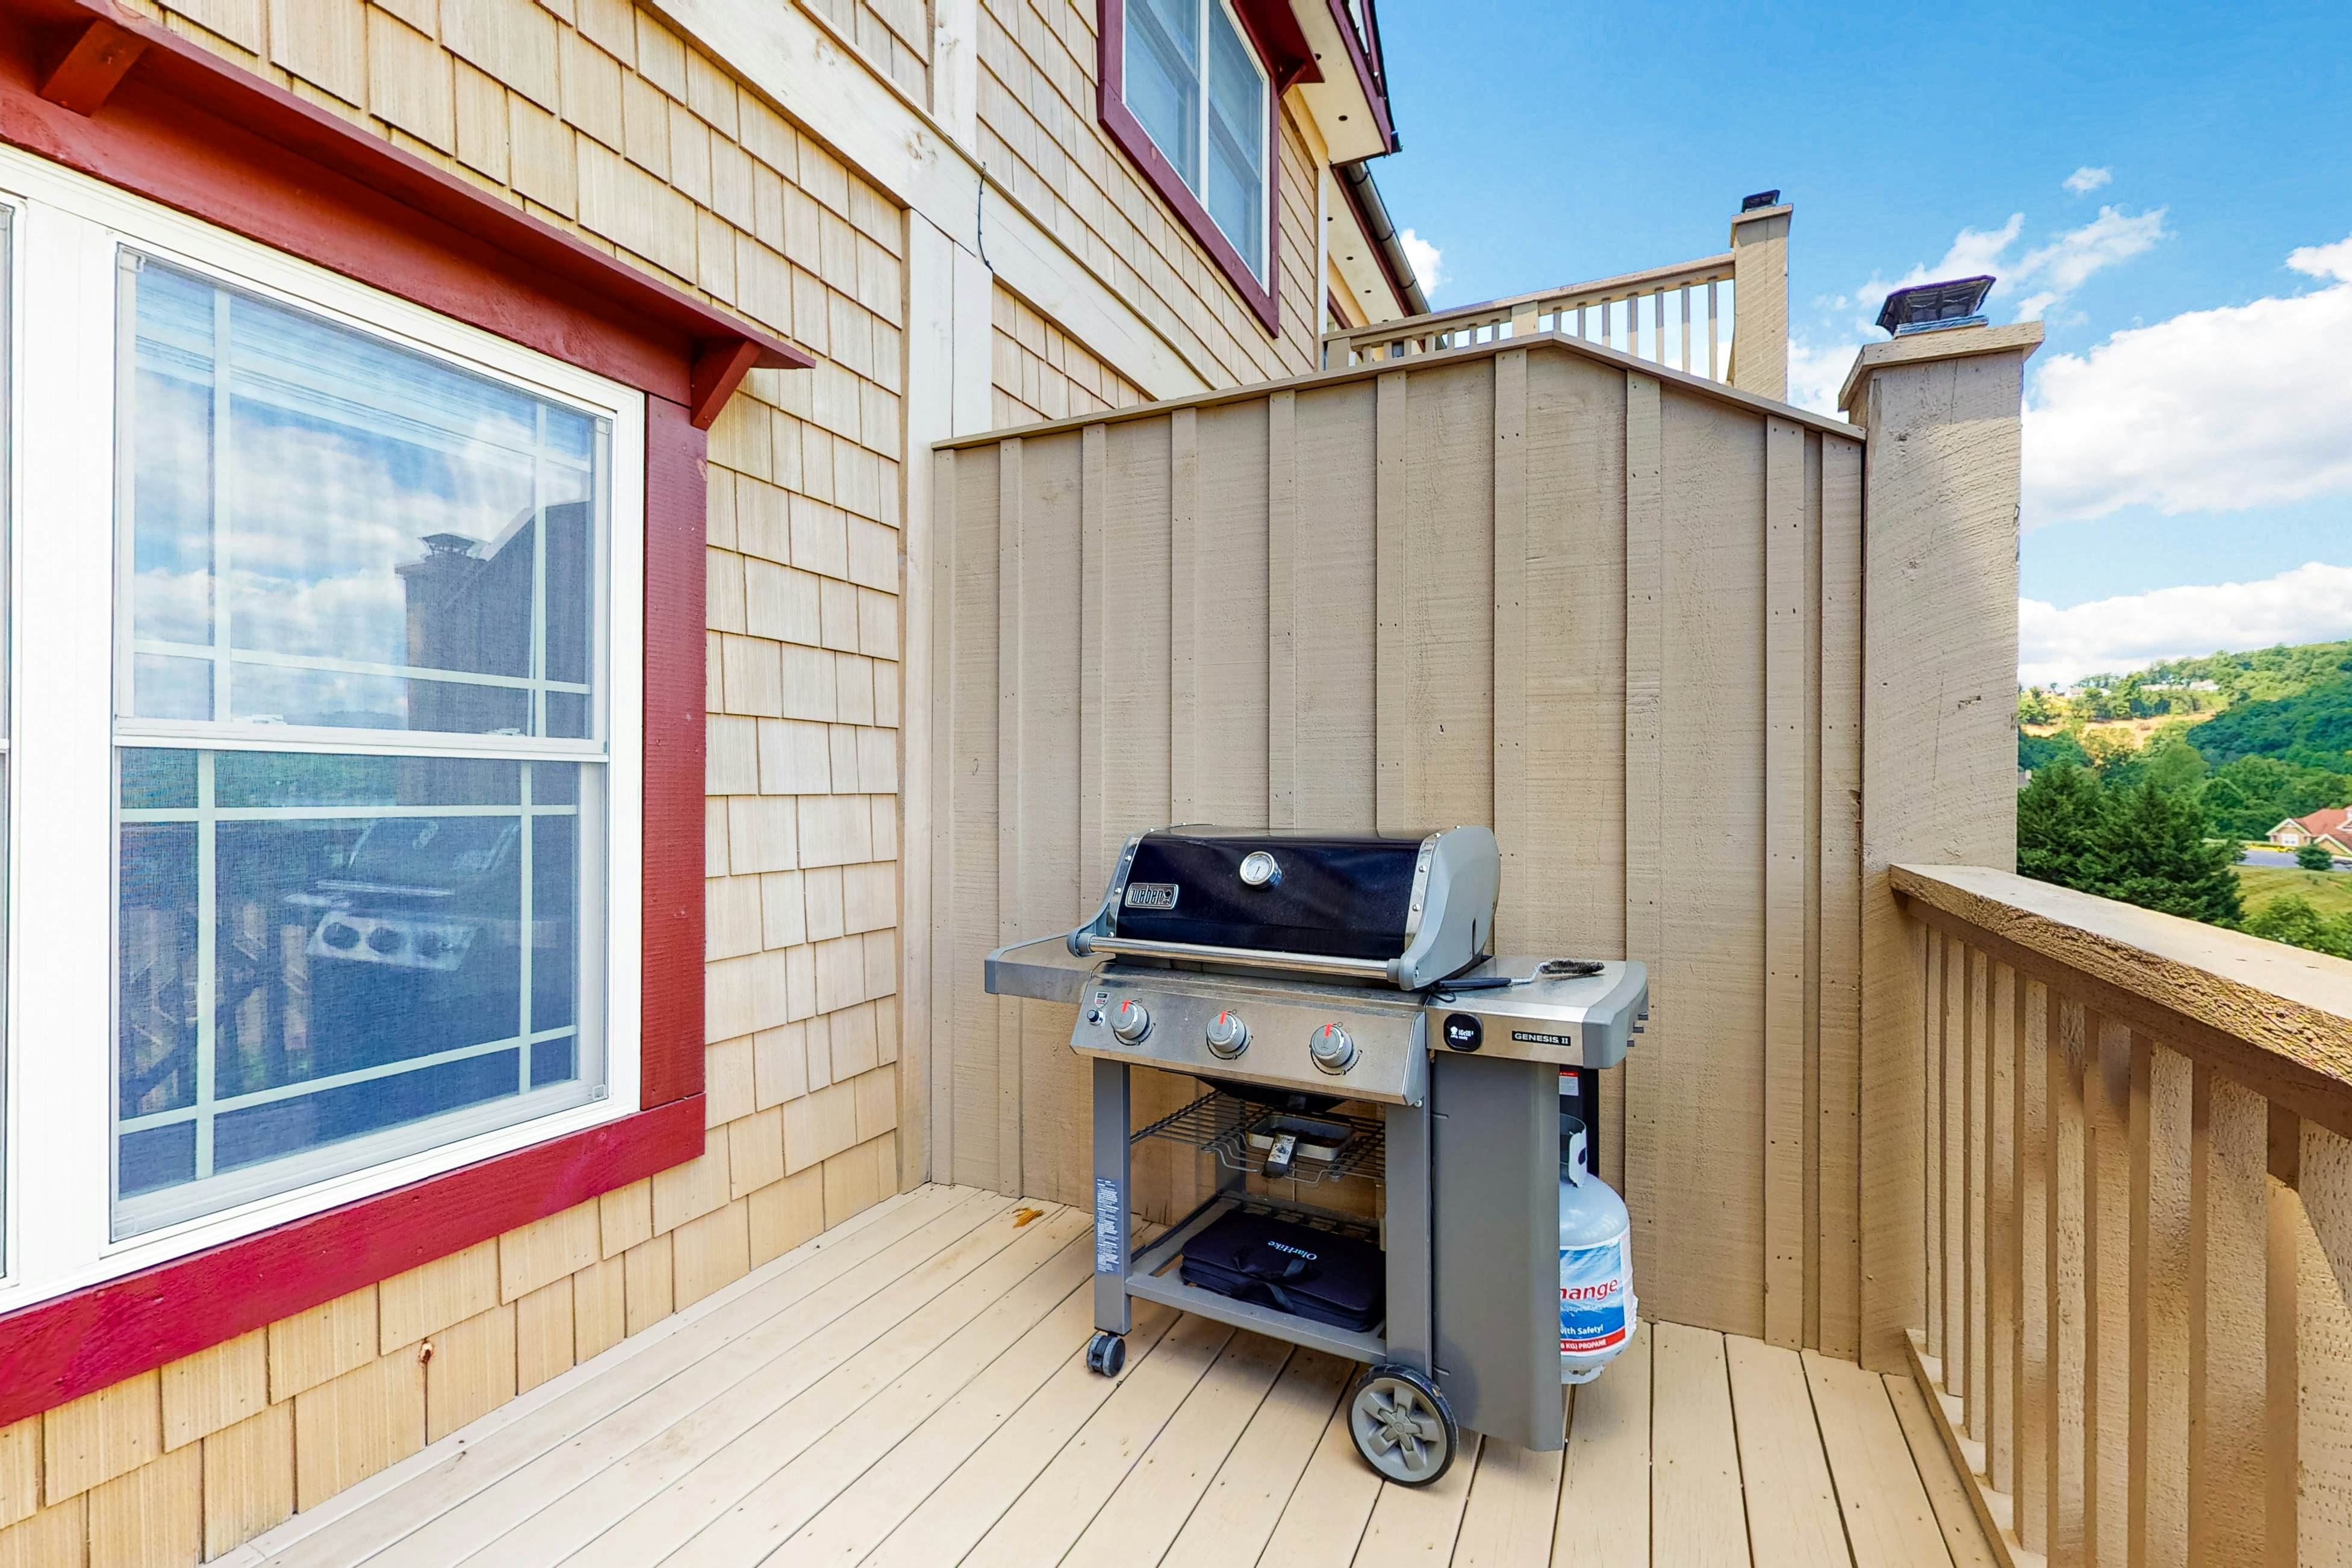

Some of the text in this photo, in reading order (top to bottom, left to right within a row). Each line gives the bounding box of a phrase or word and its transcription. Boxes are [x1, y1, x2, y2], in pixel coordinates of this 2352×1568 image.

[1131, 885, 1165, 904] weber
[1514, 1033, 1558, 1044] GENESIS
[1268, 1241, 1317, 1260] OlarHike
[1577, 1324, 1604, 1335] Safety!
[1578, 1339, 1607, 1349] PROPANE
